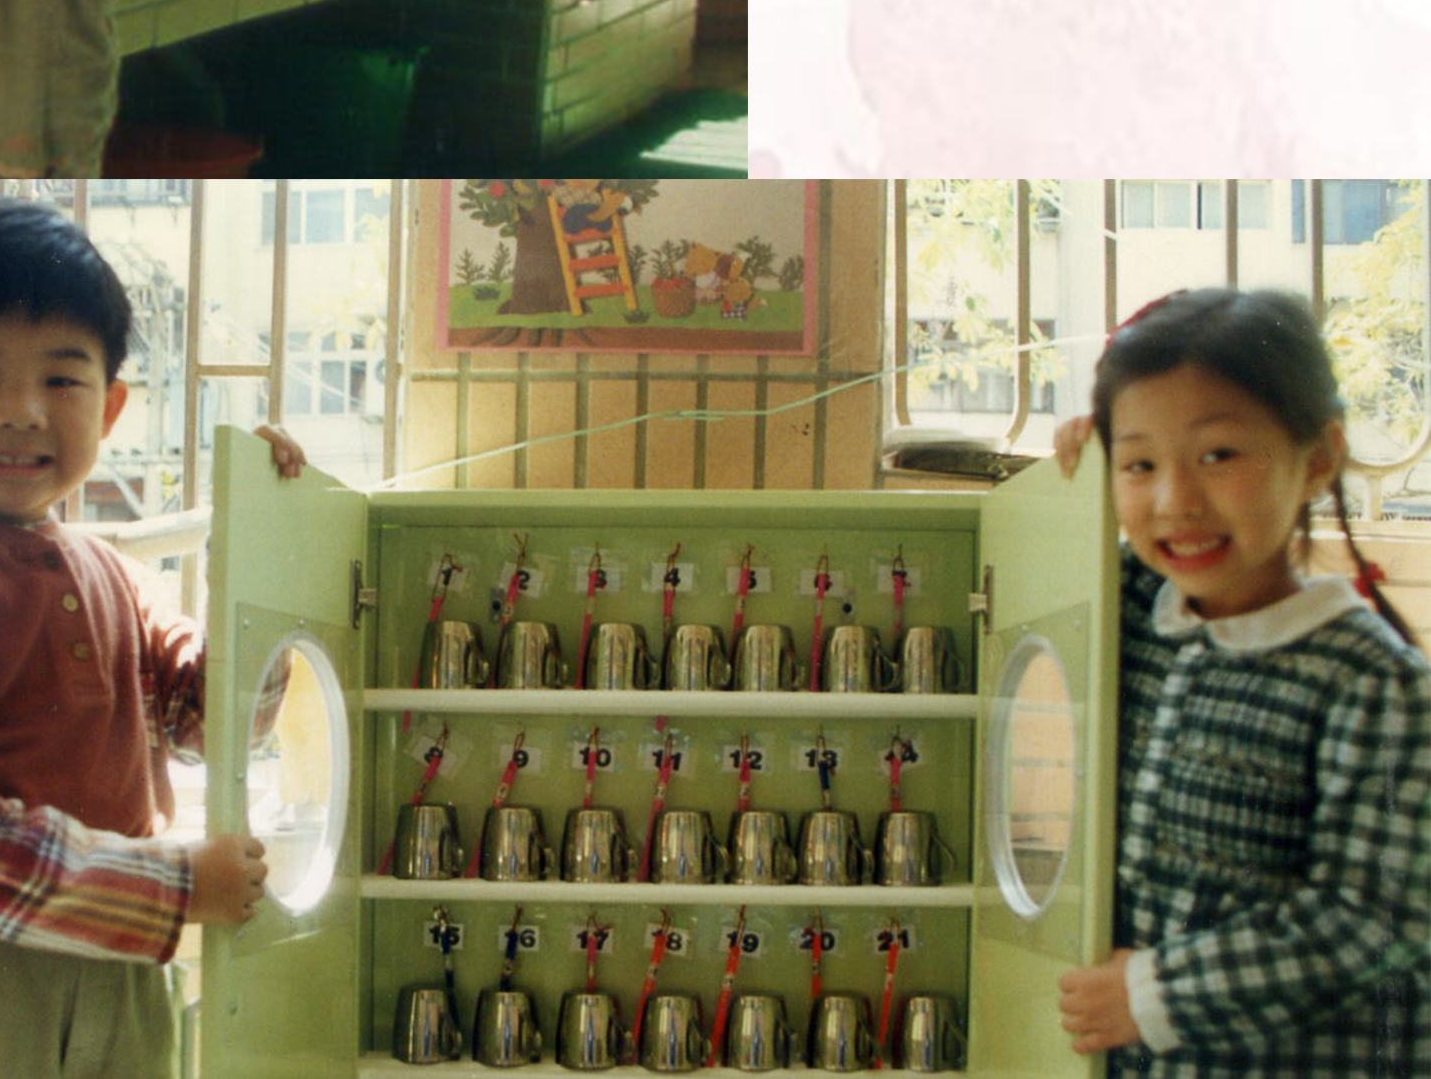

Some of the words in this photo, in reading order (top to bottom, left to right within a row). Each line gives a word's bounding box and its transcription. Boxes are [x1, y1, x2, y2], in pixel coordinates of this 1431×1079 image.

[441, 567, 453, 587] 1
[663, 567, 680, 587] 4
[512, 749, 529, 768] 9
[579, 747, 611, 768] 10
[652, 749, 682, 771] 11
[729, 749, 763, 770] 12
[805, 749, 838, 771] 13
[576, 929, 609, 950] 17
[727, 930, 759, 953] 19
[799, 927, 835, 951] 20
[876, 929, 909, 952] 21
